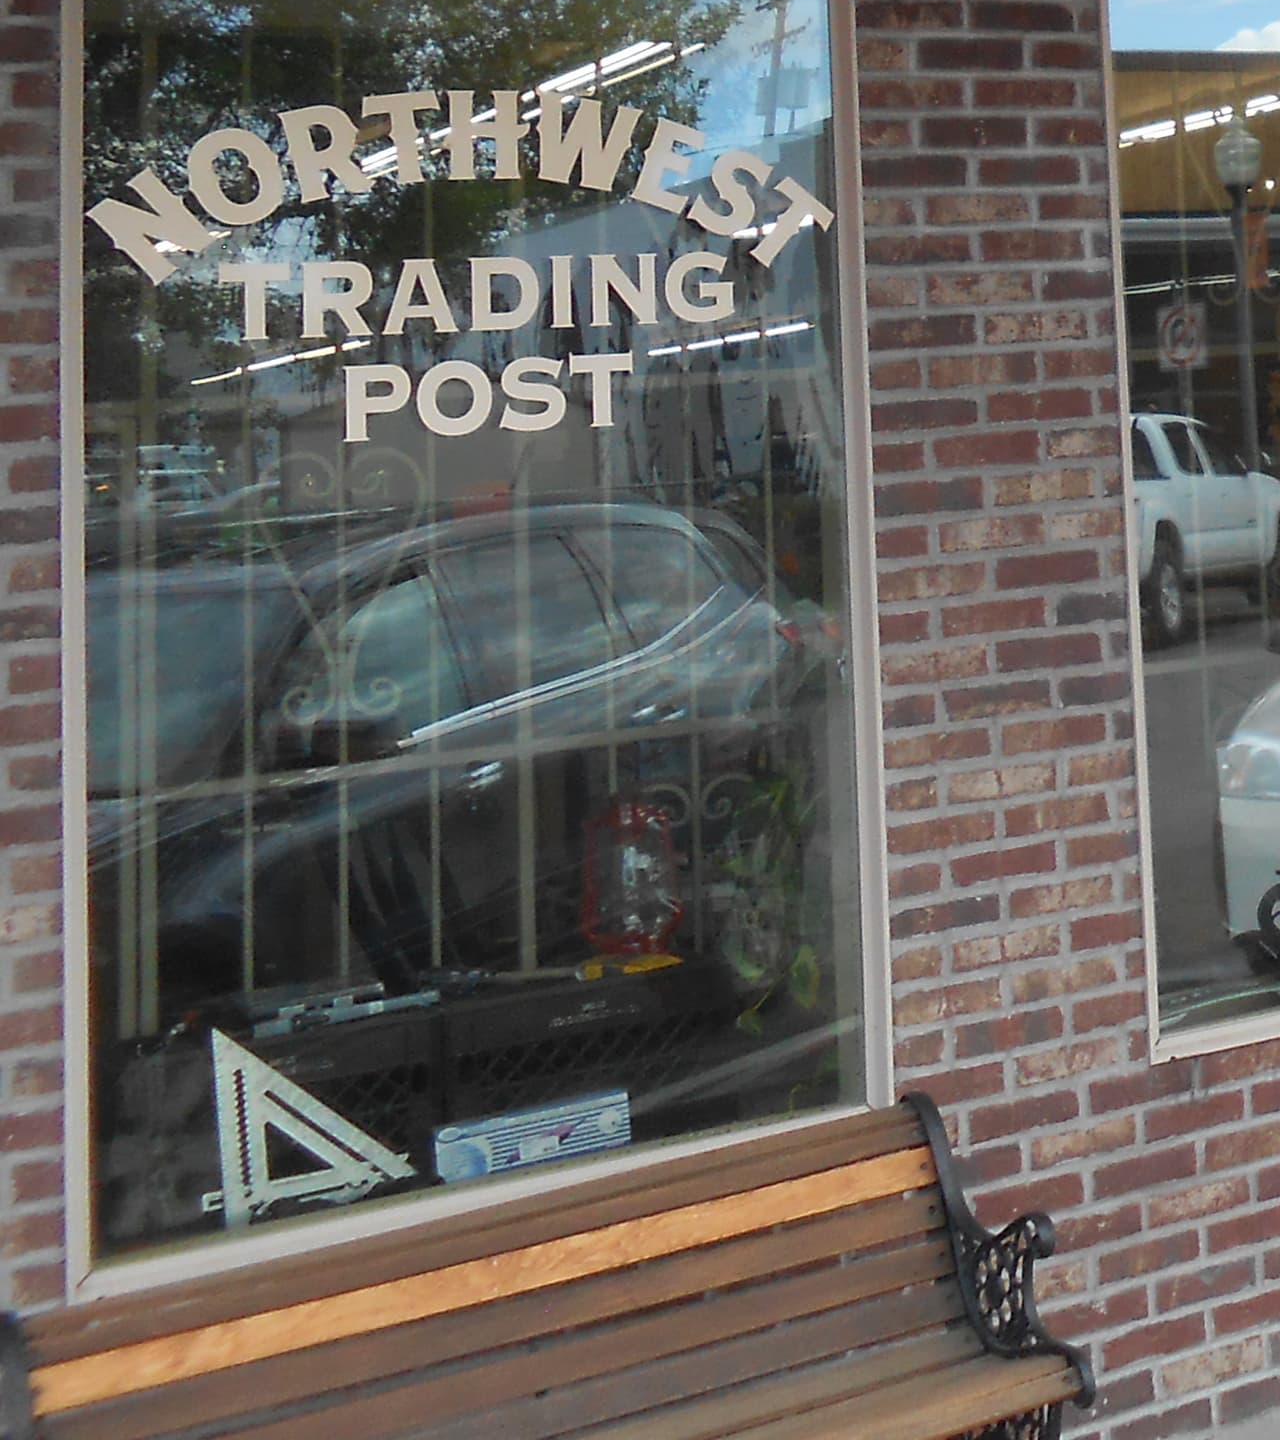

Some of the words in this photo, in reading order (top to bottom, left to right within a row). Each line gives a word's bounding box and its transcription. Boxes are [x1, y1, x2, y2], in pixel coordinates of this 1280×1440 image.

[86, 89, 836, 286] NORTHWEST
[217, 253, 738, 341] TRADING
[342, 351, 634, 442] POST
